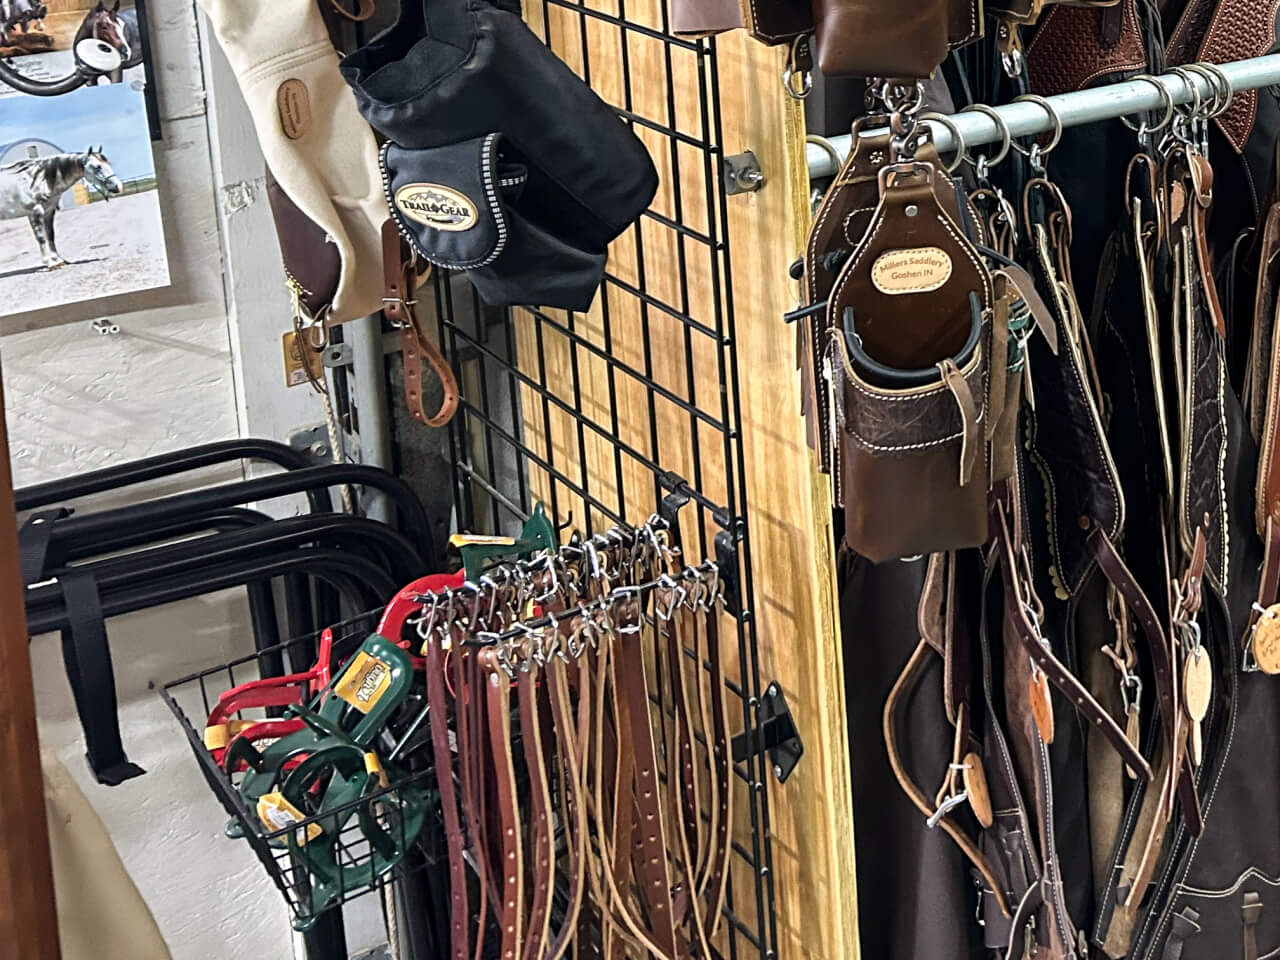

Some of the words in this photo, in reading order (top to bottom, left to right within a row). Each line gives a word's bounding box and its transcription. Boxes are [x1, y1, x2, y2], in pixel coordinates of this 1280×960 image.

[400, 199, 431, 212] TRAIL
[440, 203, 471, 217] GEAR
[880, 259, 908, 272] Millers
[909, 256, 944, 267] Saddlery
[891, 271, 922, 280] Goshen
